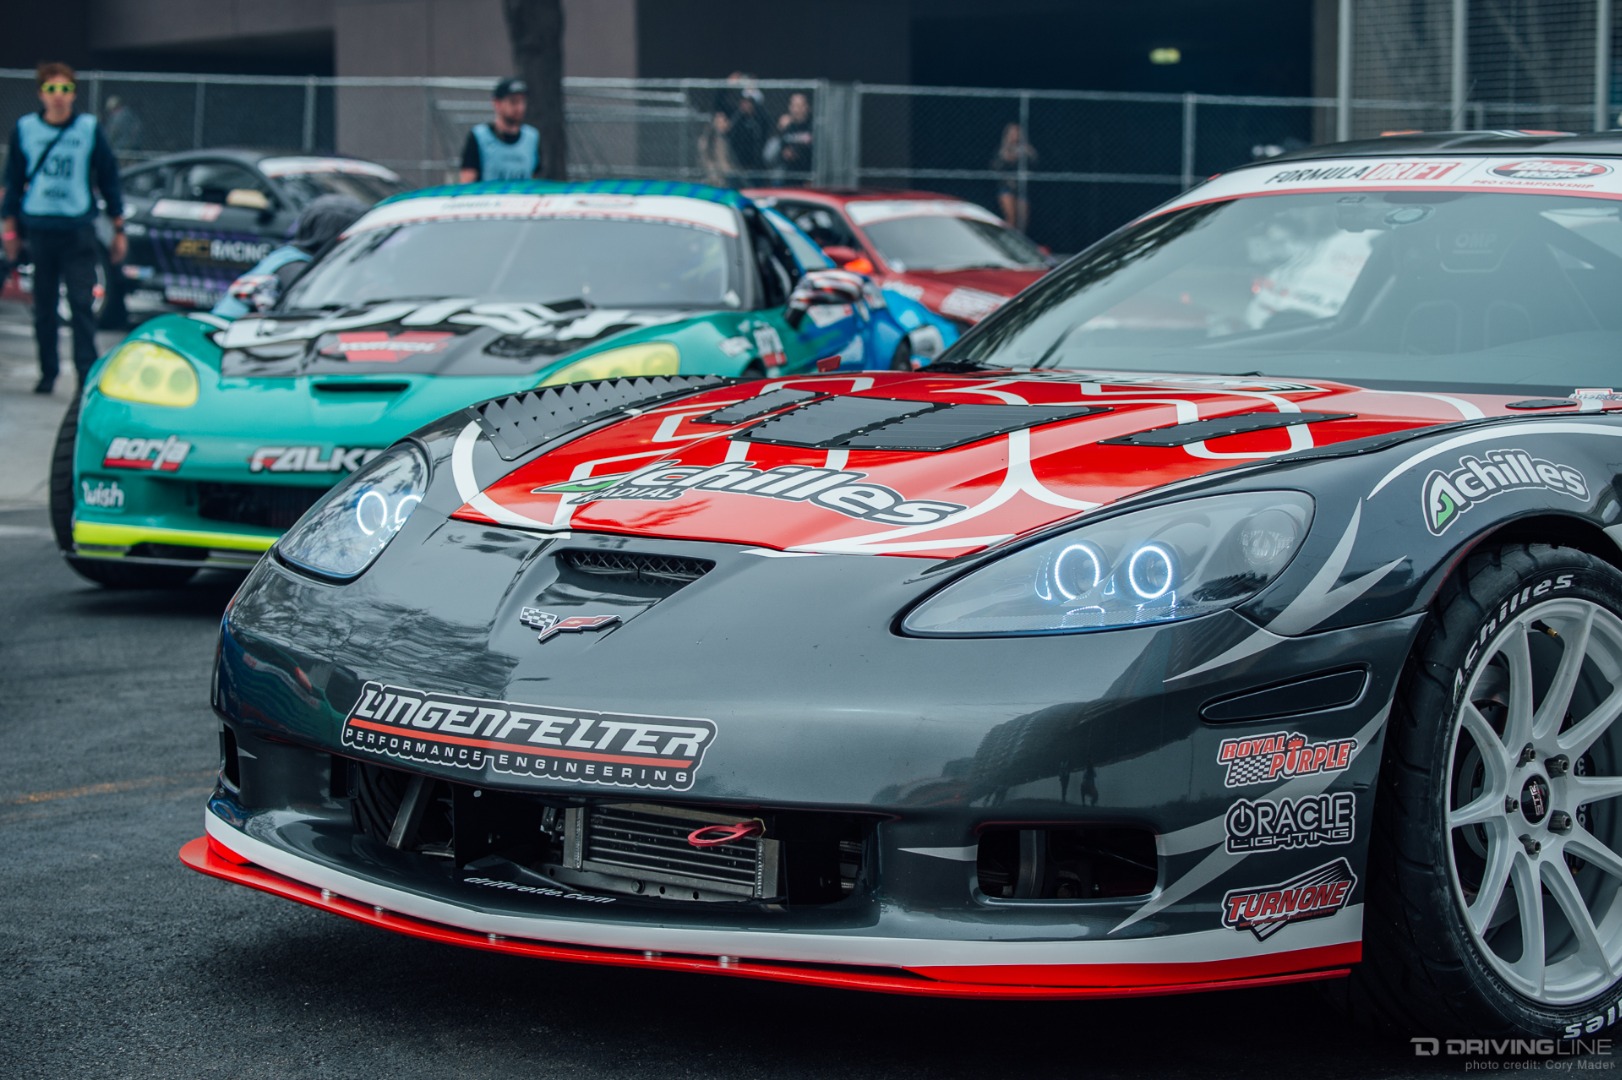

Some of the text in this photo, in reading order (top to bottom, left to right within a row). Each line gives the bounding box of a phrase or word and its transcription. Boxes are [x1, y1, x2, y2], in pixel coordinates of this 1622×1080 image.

[1264, 162, 1461, 184] FORMULA DRIFT
[1499, 180, 1595, 190] CHAMPIONSHIP
[530, 459, 969, 526] Achilles
[573, 486, 684, 504] RADIAL
[1429, 453, 1587, 530] Achilles
[355, 688, 711, 758] LINGENFELTER
[345, 727, 688, 783] PERFORMANCE ENGINEERING
[1221, 735, 1285, 760] ROYAL
[1268, 742, 1351, 778] PURPLE
[1229, 797, 1350, 838] ORACLE
[1230, 828, 1350, 849] LIGHTING
[1227, 880, 1352, 922] TURNONE
